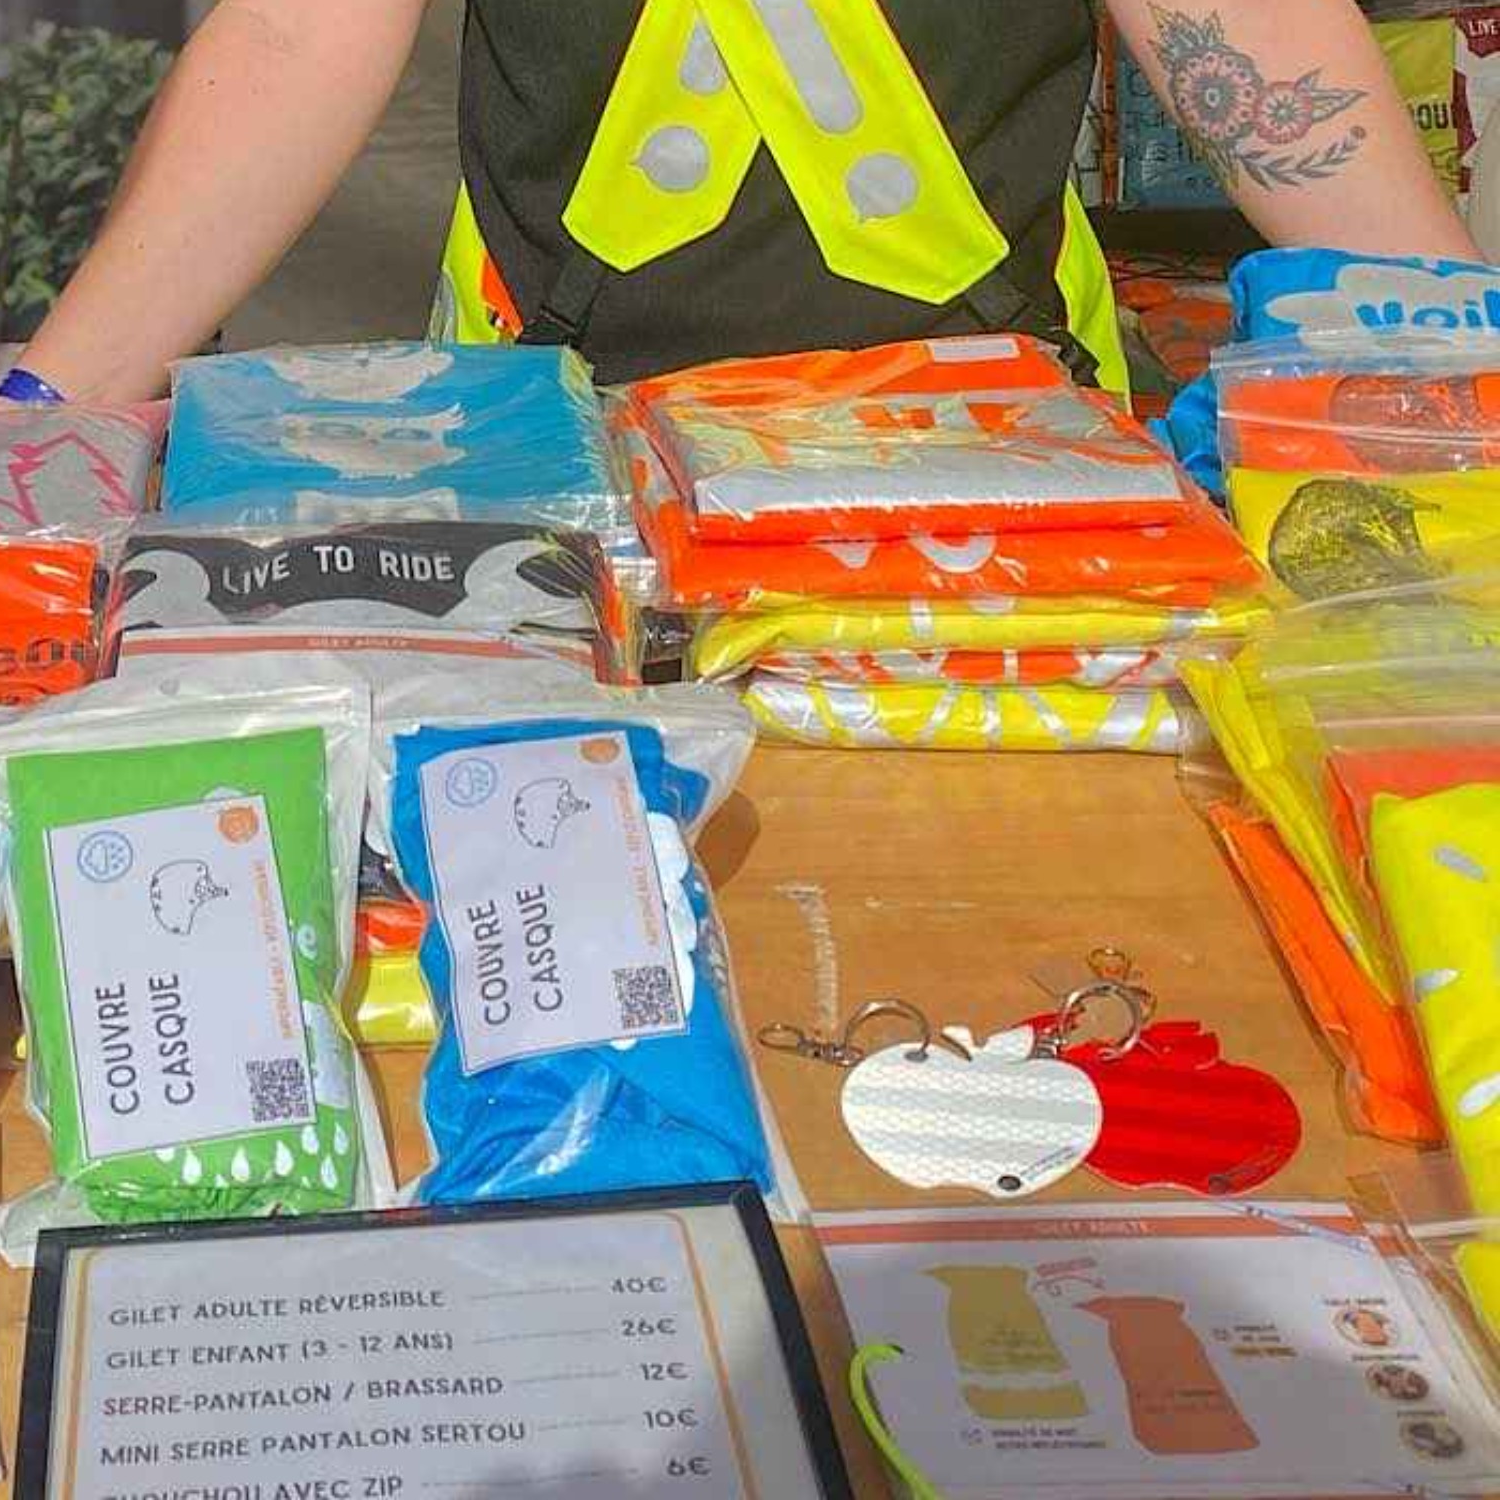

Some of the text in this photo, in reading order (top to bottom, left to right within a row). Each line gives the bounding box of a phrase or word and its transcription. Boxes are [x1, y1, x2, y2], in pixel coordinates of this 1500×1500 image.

[223, 546, 454, 594] LIVE TO RIDE
[467, 900, 511, 1026] COUVRE
[516, 883, 564, 1012] CASQUE
[95, 982, 140, 1115] COUVRE
[149, 973, 194, 1105] CASQUE
[108, 1305, 181, 1326] GILET
[192, 1299, 287, 1319] ADULTE
[611, 1276, 667, 1295] 40€
[105, 1346, 180, 1370] GILET
[192, 1342, 288, 1364] ENFANT
[301, 1339, 328, 1360] (3
[360, 1336, 383, 1353] 12
[394, 1331, 454, 1351] ANS)
[621, 1317, 678, 1337] 26€
[102, 1361, 689, 1417] SERRE-PANTALON / BRASSARD 12€
[100, 1408, 700, 1467] MINI SERRE PANTALON SERTOU 10€
[276, 1478, 350, 1500] AVEC
[362, 1474, 404, 1497] ZIP
[666, 1456, 713, 1477] 6€
